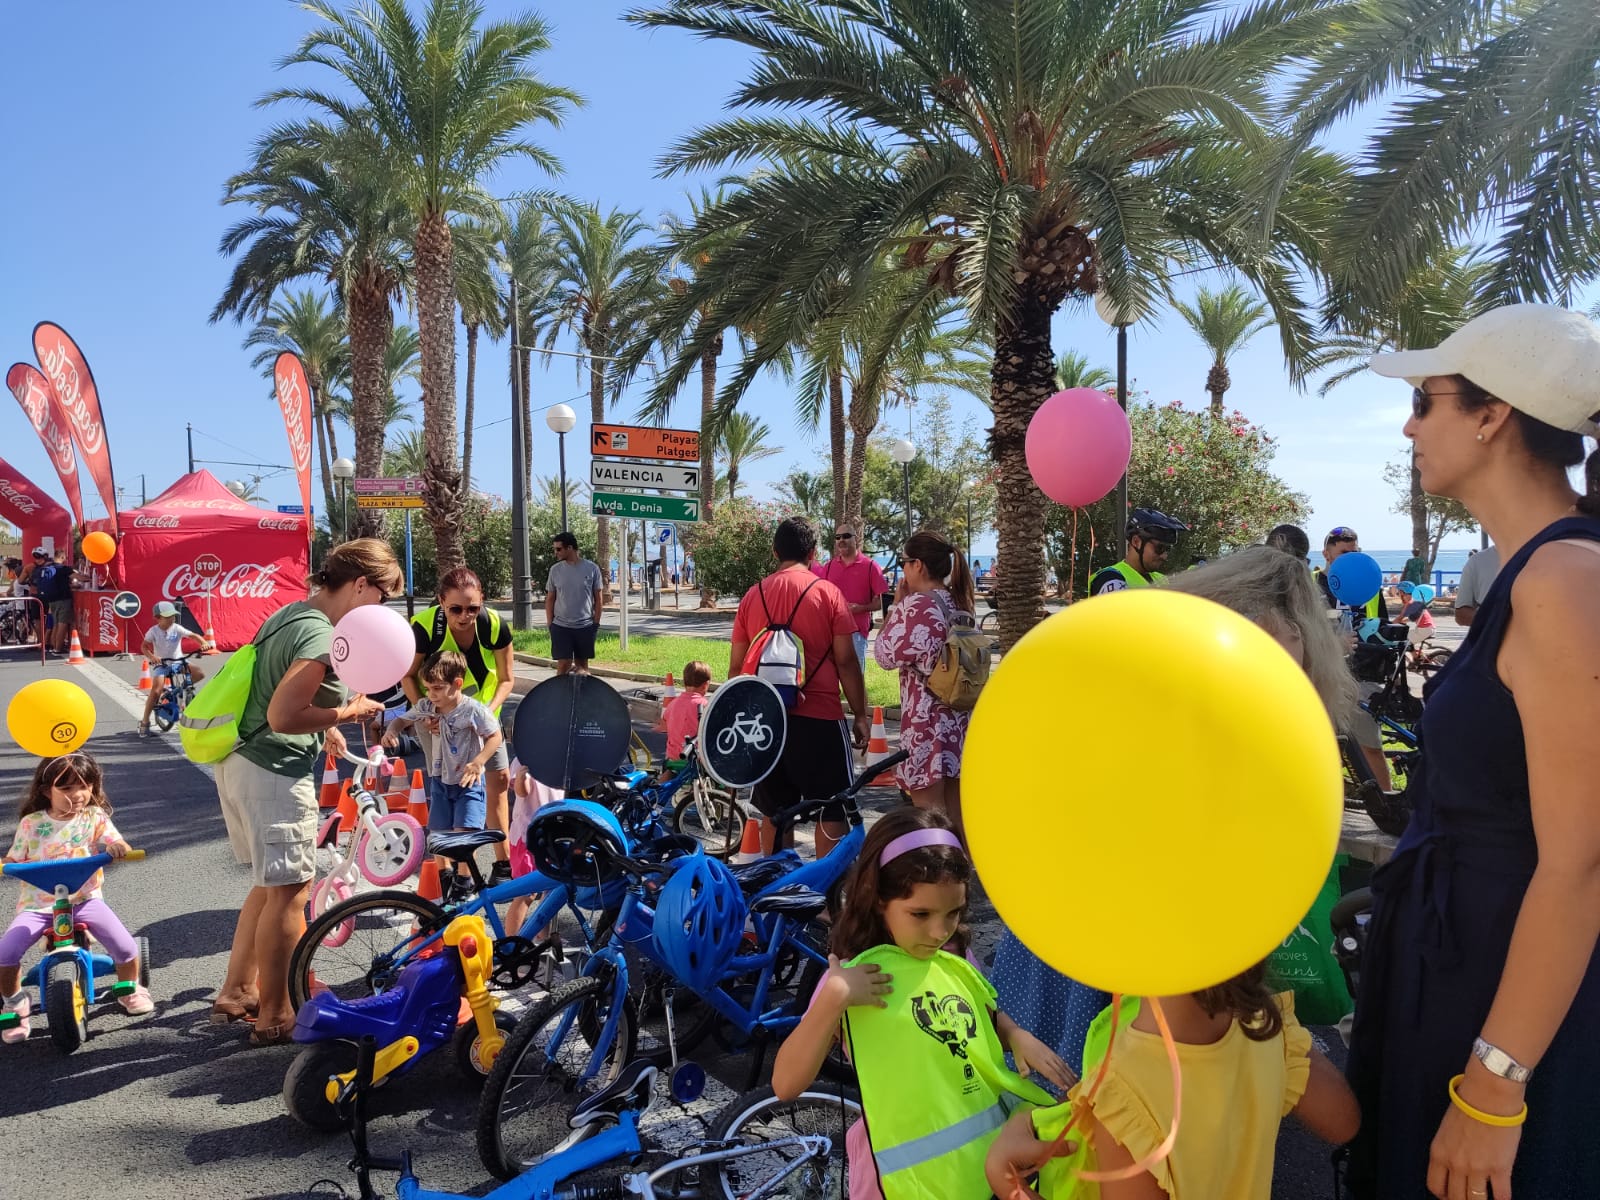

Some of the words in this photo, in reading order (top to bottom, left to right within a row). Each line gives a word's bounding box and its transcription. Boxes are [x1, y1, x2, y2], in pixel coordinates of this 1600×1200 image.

[662, 433, 698, 446] Playas
[656, 445, 697, 458] Platges
[595, 467, 664, 483] VALENCIA
[594, 499, 626, 511] Avda.
[631, 501, 663, 513] Denia
[196, 561, 220, 571] STOP
[334, 642, 345, 657] 30
[56, 727, 73, 739] 30
